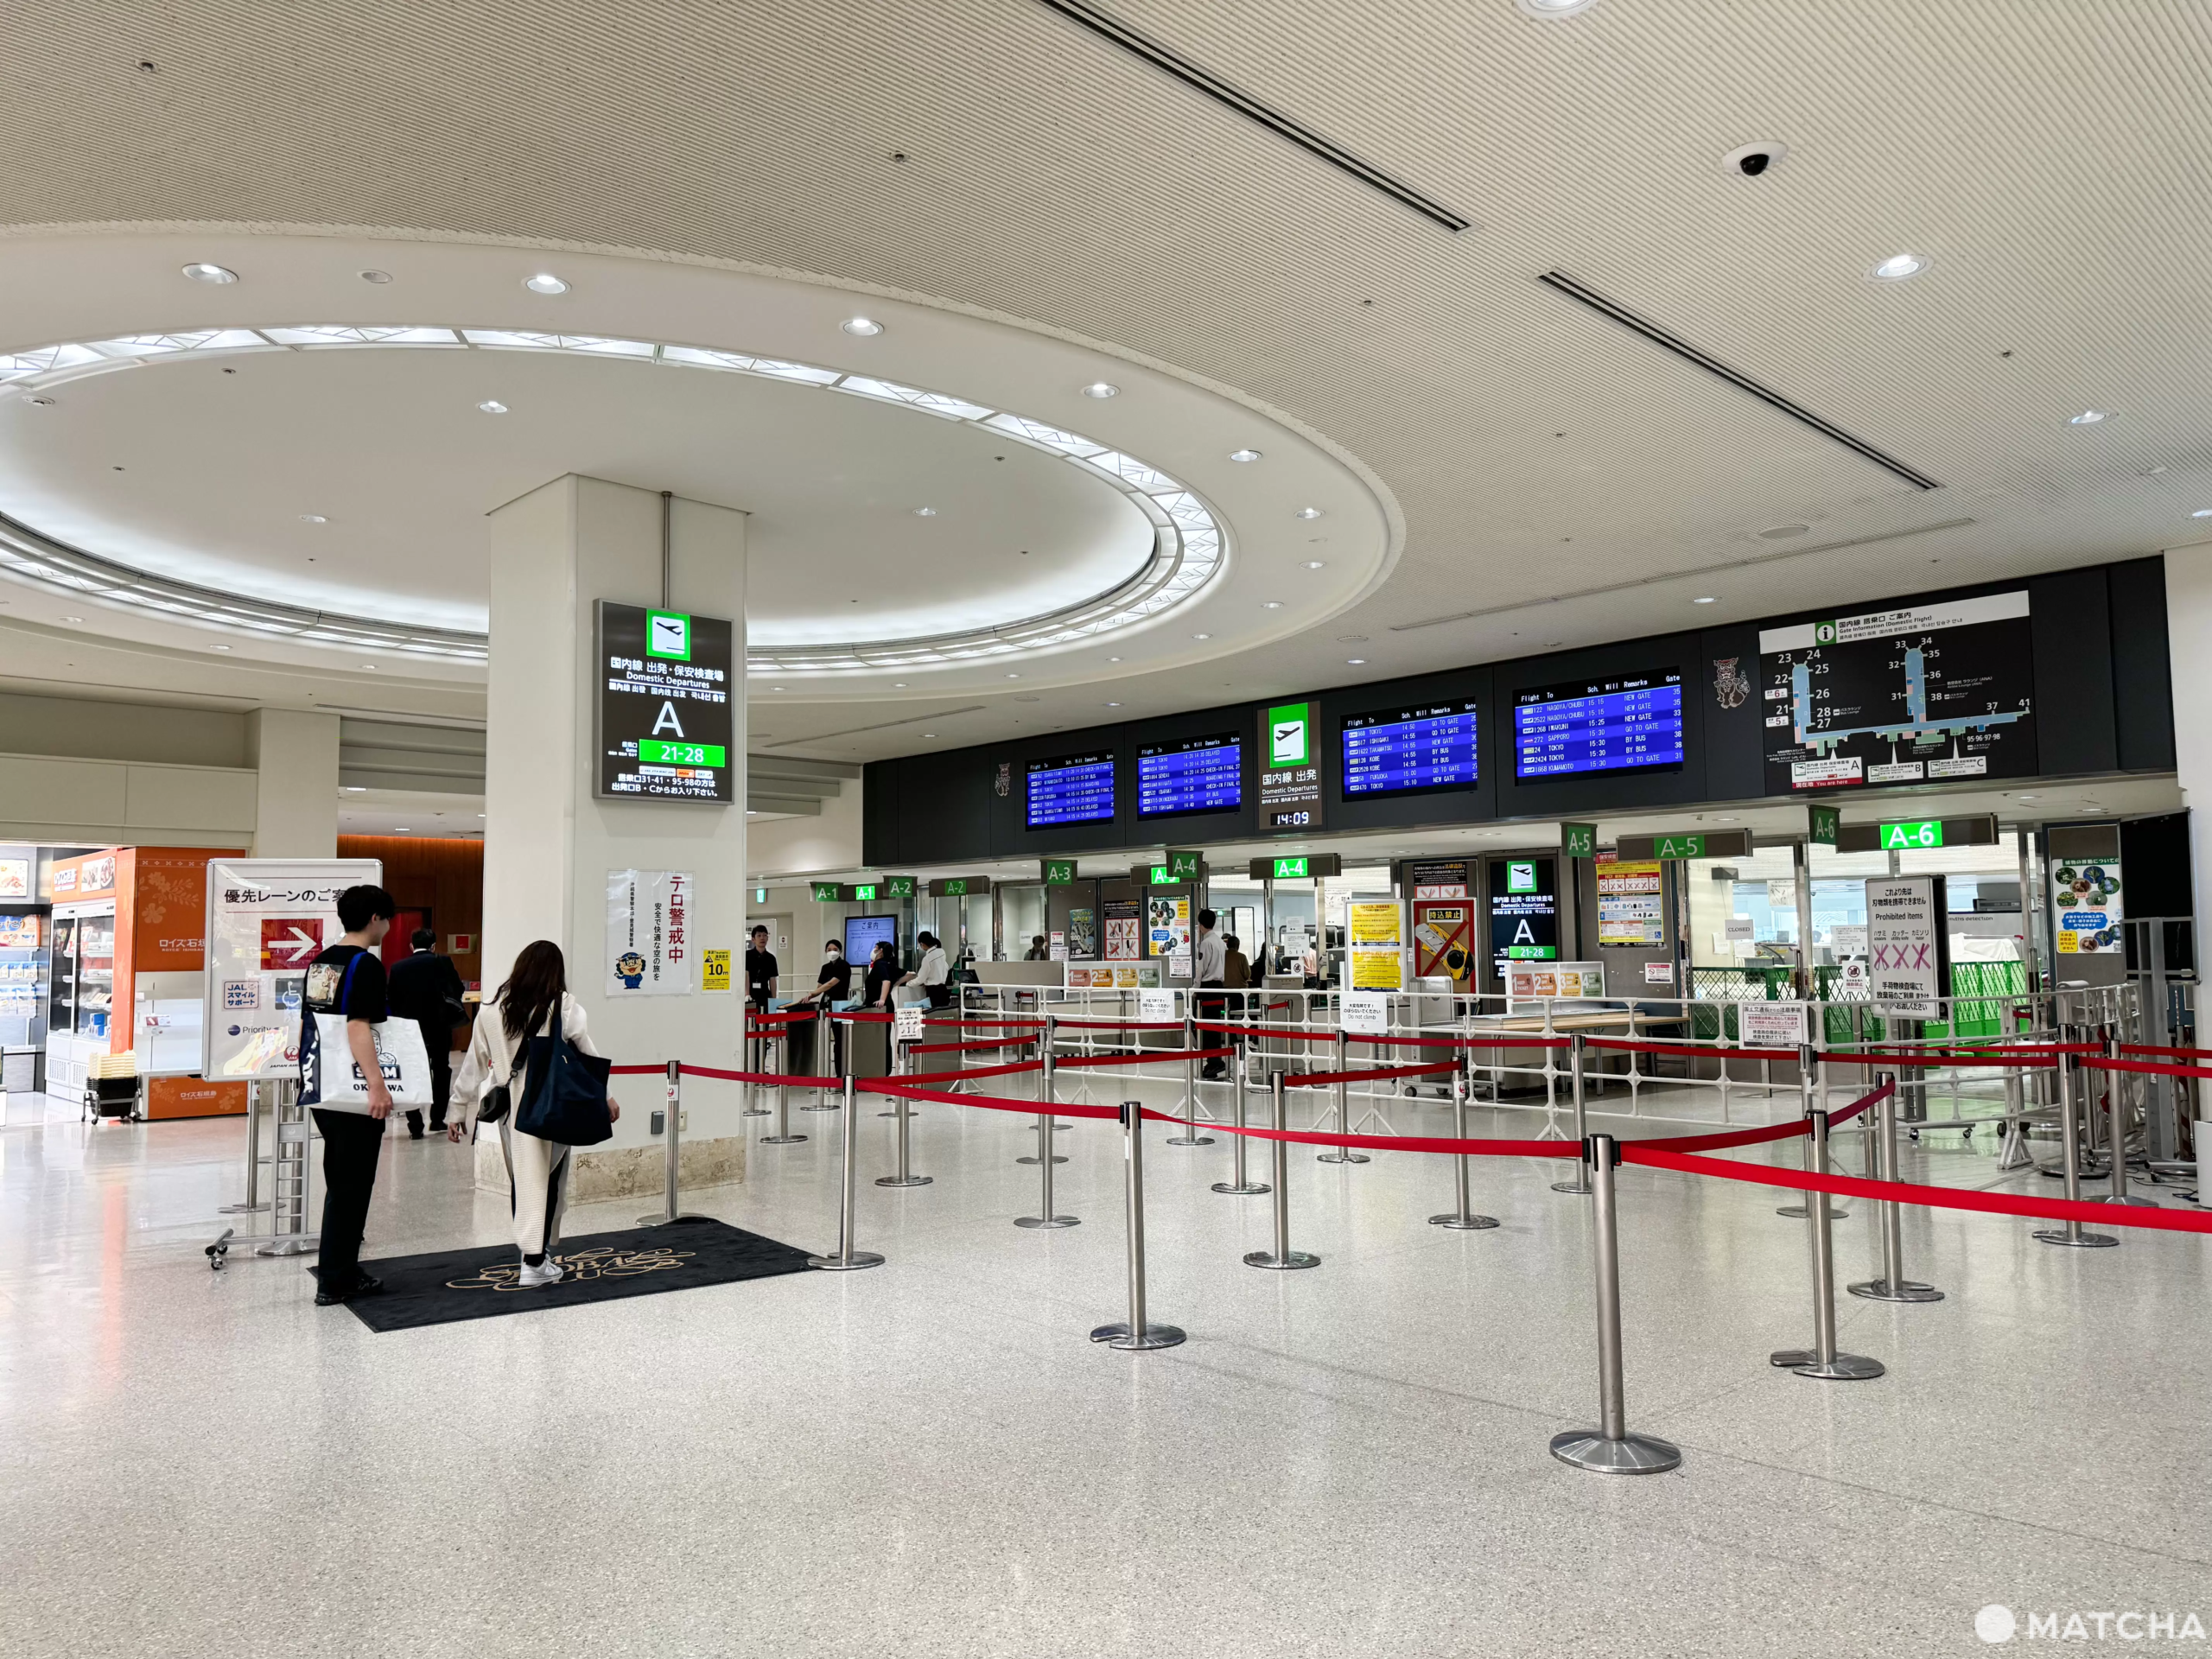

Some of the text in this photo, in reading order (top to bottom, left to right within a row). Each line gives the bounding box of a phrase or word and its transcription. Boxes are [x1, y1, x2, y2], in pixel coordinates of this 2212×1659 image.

[1864, 616, 1885, 625] 搭乗口
[1889, 612, 1911, 620] ご案内
[1853, 623, 1885, 632] Information
[1895, 640, 1906, 649] 33
[1921, 637, 1932, 645] 34
[1778, 653, 1791, 664] 23
[1807, 649, 1821, 659] 24
[610, 657, 724, 682] 国内線 出発・保安検査場
[1815, 664, 1829, 674] 25
[1929, 671, 1941, 679] 36
[626, 671, 710, 690] Domestic Departures
[1624, 679, 1648, 688] Remarks
[1775, 674, 1789, 684] 22
[1815, 689, 1830, 699] 26
[1547, 701, 1585, 711] NAGOYA/CHUBU
[1777, 704, 1789, 715] 21
[1817, 707, 1831, 717] 28
[652, 701, 684, 738] A
[1547, 711, 1585, 721] NAGOYA/CHUBU
[1548, 723, 1568, 732] IWAKUNI
[1817, 718, 1831, 728] 27
[661, 746, 704, 763] 21-28
[1548, 763, 1573, 772] KUMAMOTO
[1851, 760, 1859, 770] A
[1262, 769, 1317, 785] 国内線 出発
[1262, 785, 1318, 795] Domestic Departures
[1277, 811, 1309, 825] 14:09
[1815, 817, 1834, 838] A-6
[1889, 824, 1934, 846] A-6
[1569, 832, 1590, 851] A-5
[1661, 837, 1697, 856] A-5
[1174, 858, 1196, 873] A-4
[1279, 861, 1303, 875] A-4
[1049, 867, 1070, 880] A-3
[818, 887, 836, 899] A-1
[857, 887, 874, 899] A-1
[891, 882, 911, 893] A-2
[948, 881, 963, 893] A-2
[225, 888, 345, 903] 優先レーンのご案
[1872, 897, 1926, 906] 刃物類を携帯できません
[669, 876, 684, 963] テロ警戒中
[1429, 911, 1460, 919] 持込禁止
[1513, 918, 1535, 944] A
[652, 903, 662, 981] 安全で快適な空の旅を
[1520, 948, 1544, 957] 21-28
[1513, 976, 1517, 991] 1
[1535, 976, 1541, 989] 2
[1560, 976, 1566, 988] 3
[1583, 975, 1589, 988] 4
